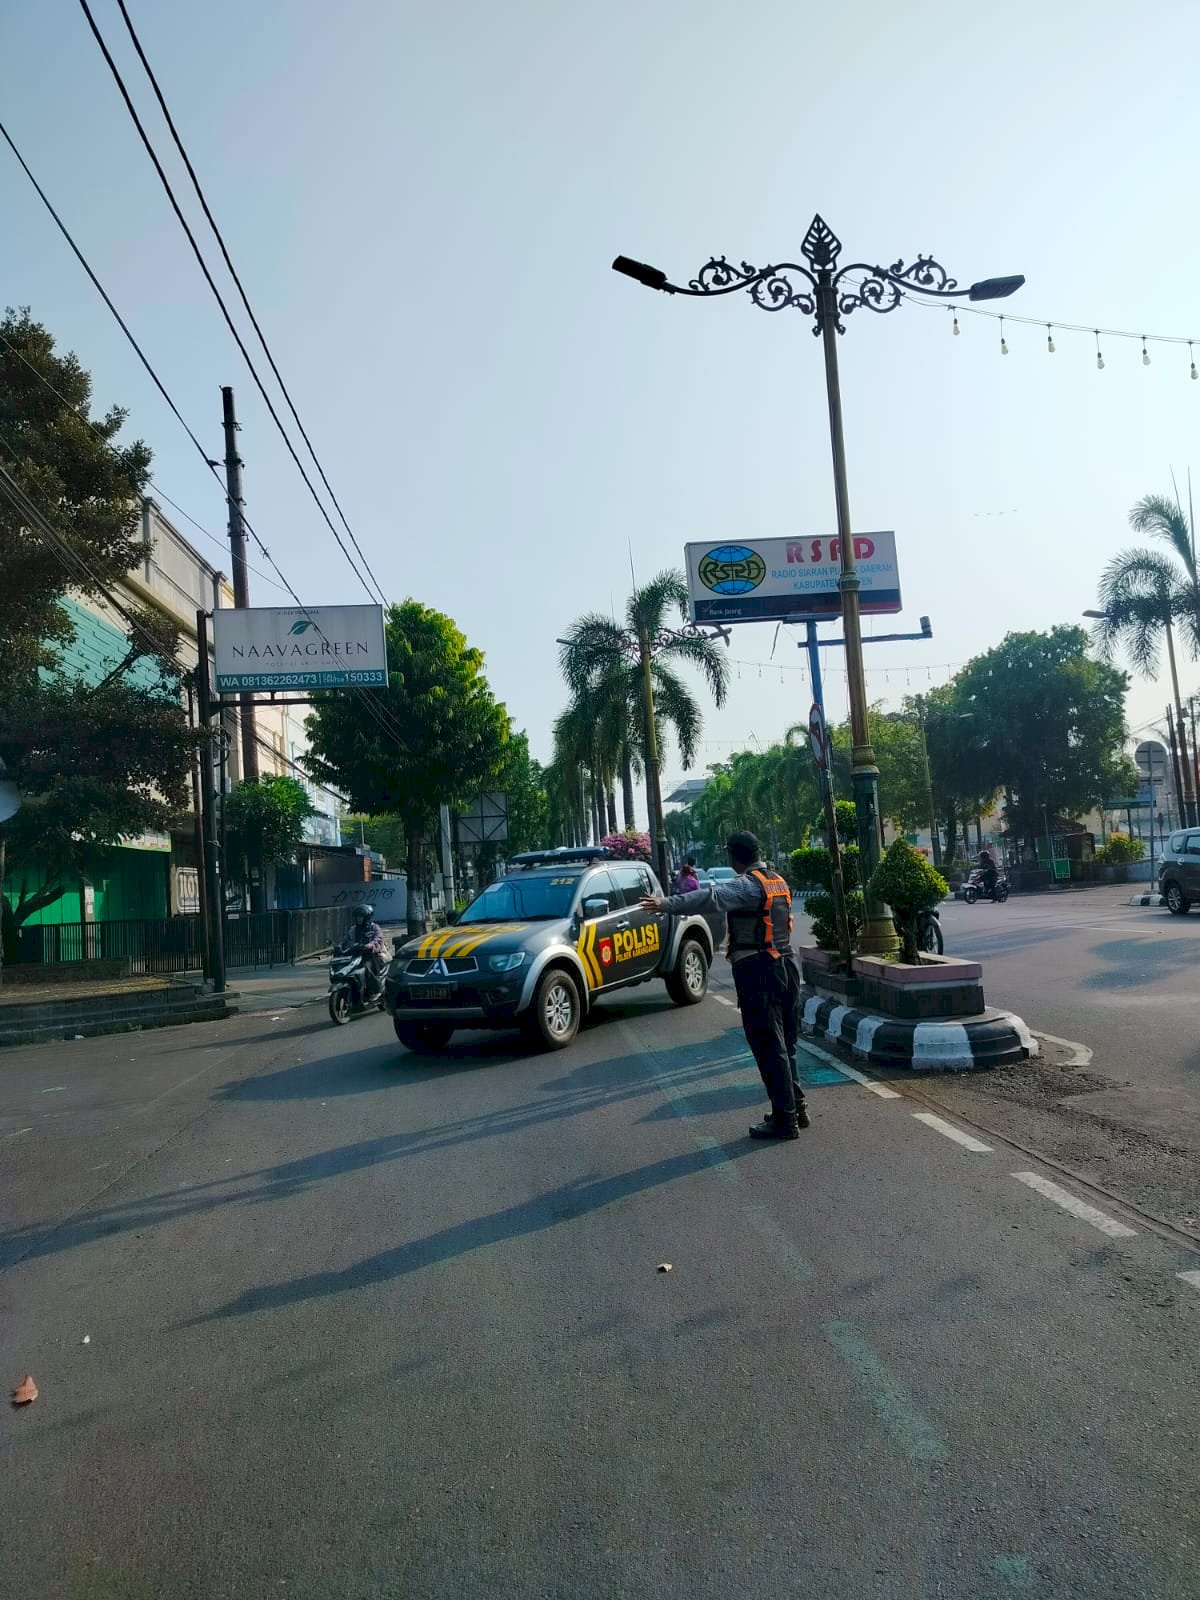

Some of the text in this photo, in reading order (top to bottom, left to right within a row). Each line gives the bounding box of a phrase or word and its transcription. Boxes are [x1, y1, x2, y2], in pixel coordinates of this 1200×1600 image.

[771, 569, 796, 579] RADIO
[798, 567, 828, 577] SIARAN
[860, 563, 892, 574] DAERAH
[232, 641, 368, 658] NAAVAGREEN
[220, 676, 240, 687] WA
[241, 673, 318, 686] 081362262473
[344, 671, 383, 682] 150333
[613, 922, 660, 957] POLISI
